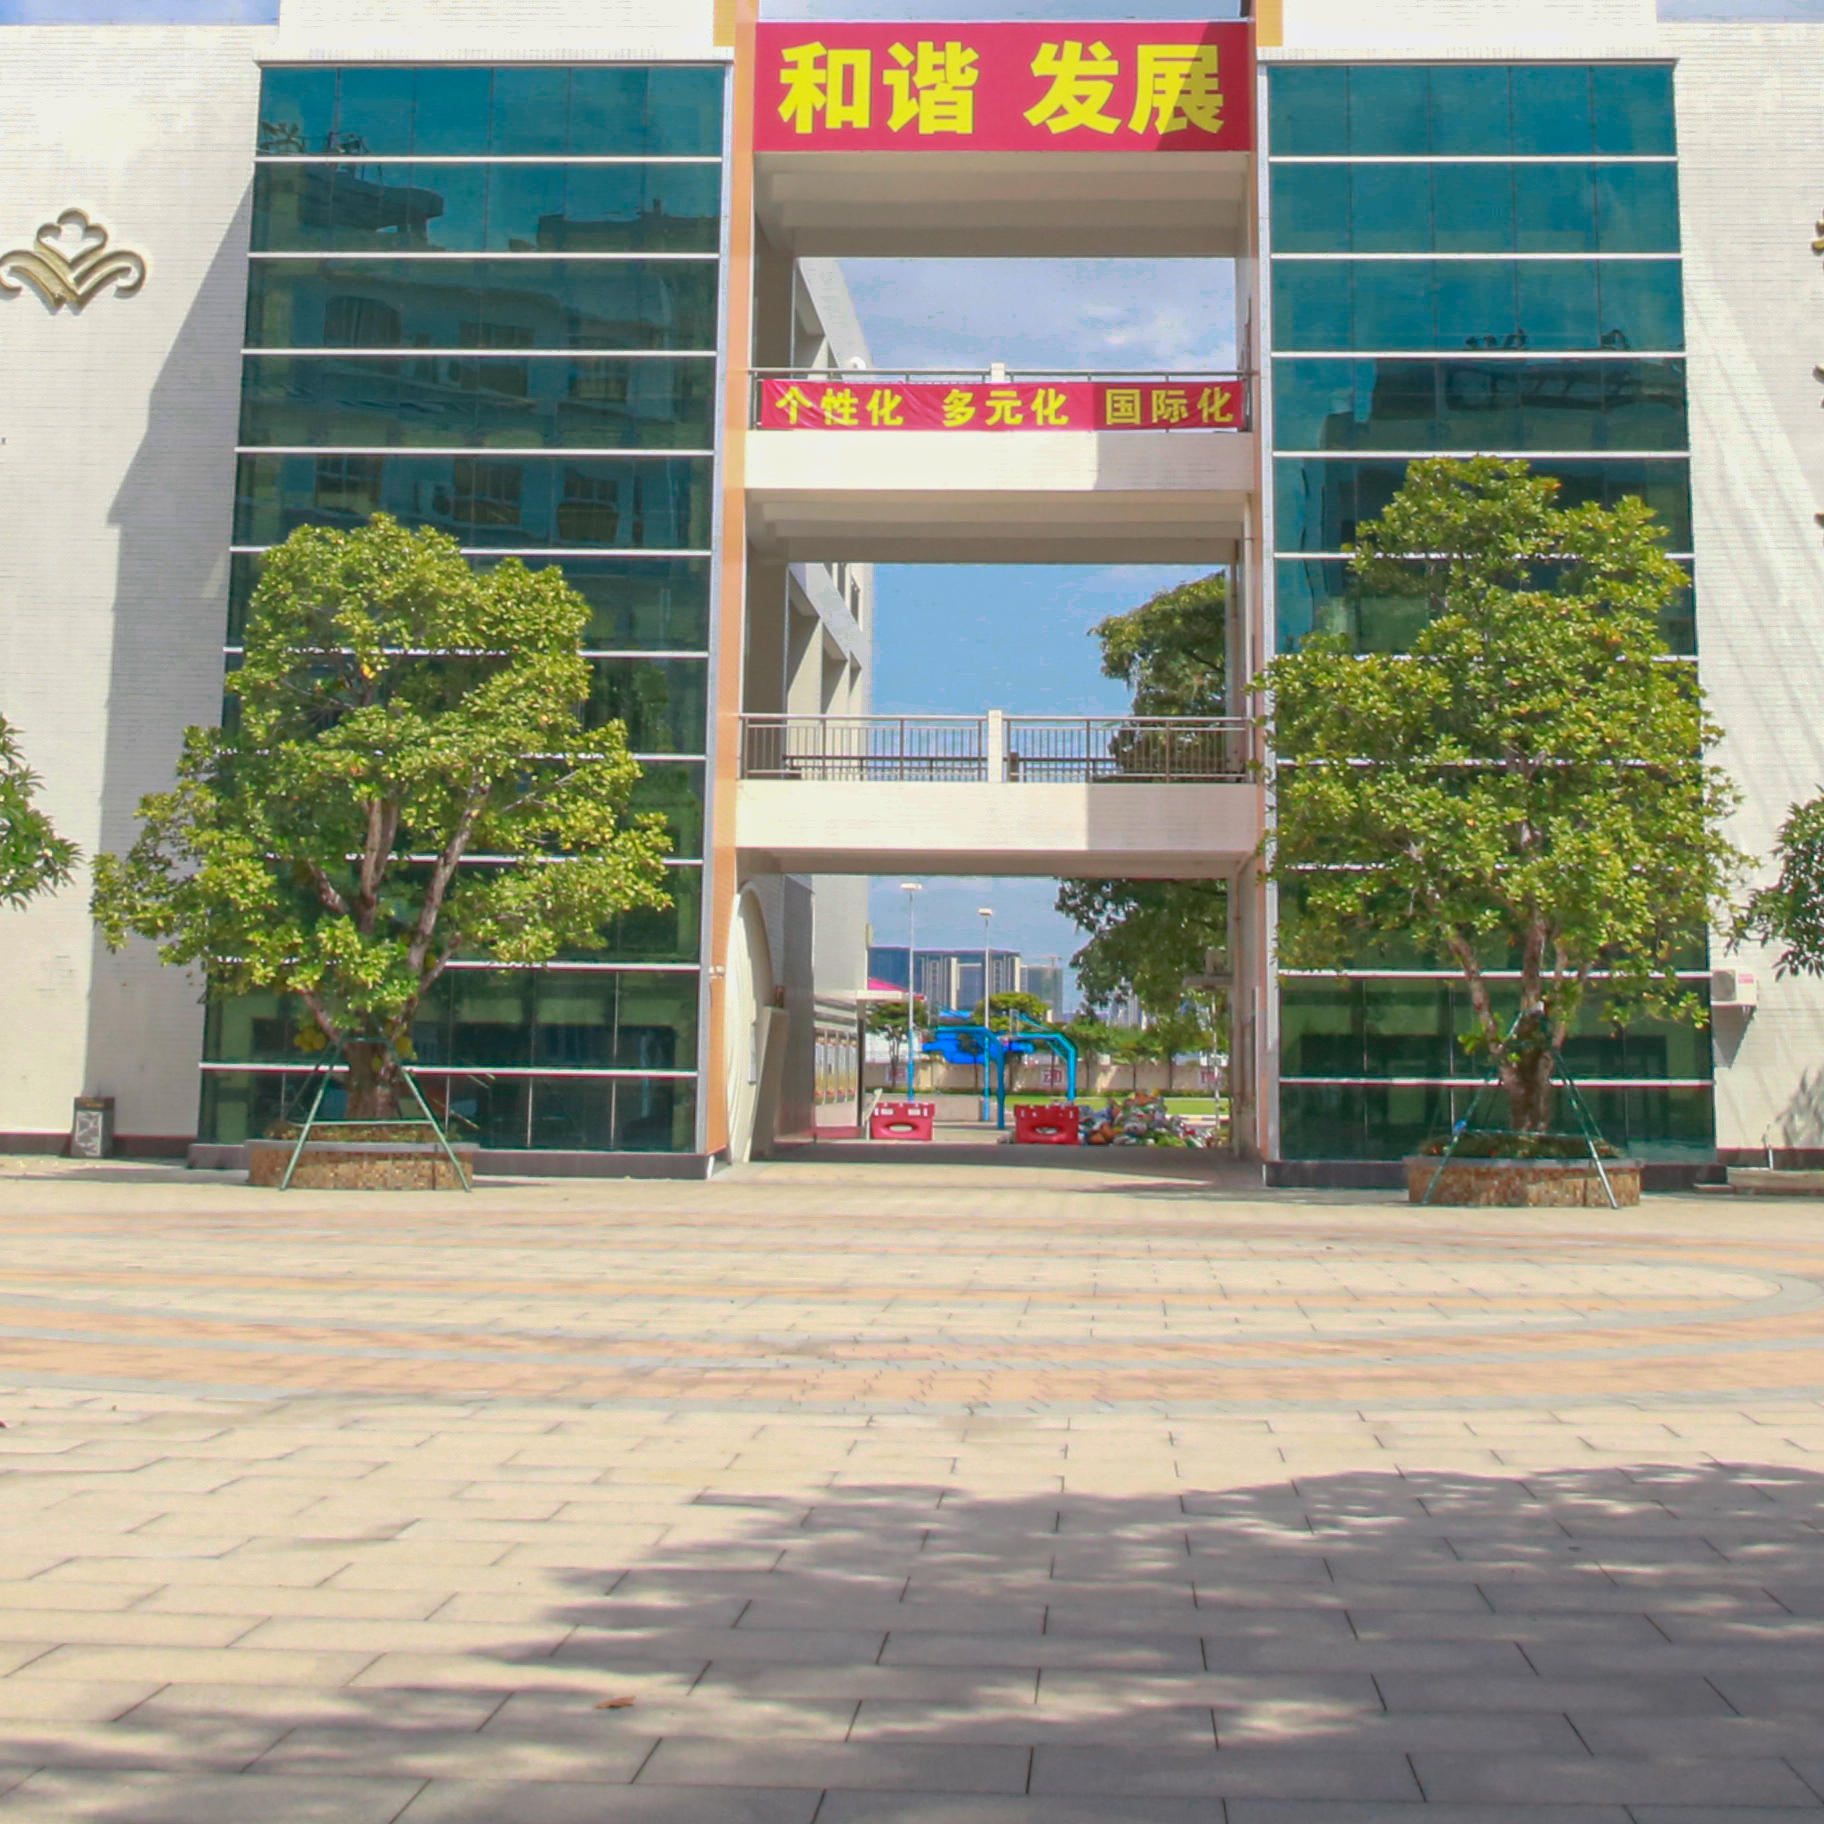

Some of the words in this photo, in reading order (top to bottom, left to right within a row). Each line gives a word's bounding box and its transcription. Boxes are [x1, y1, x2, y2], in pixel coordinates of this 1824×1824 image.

[778, 40, 980, 135] 和谐
[1024, 40, 1225, 136] 发展
[775, 386, 904, 427] 个性化
[942, 388, 1069, 428] 多元化
[1105, 387, 1234, 425] 国际化
